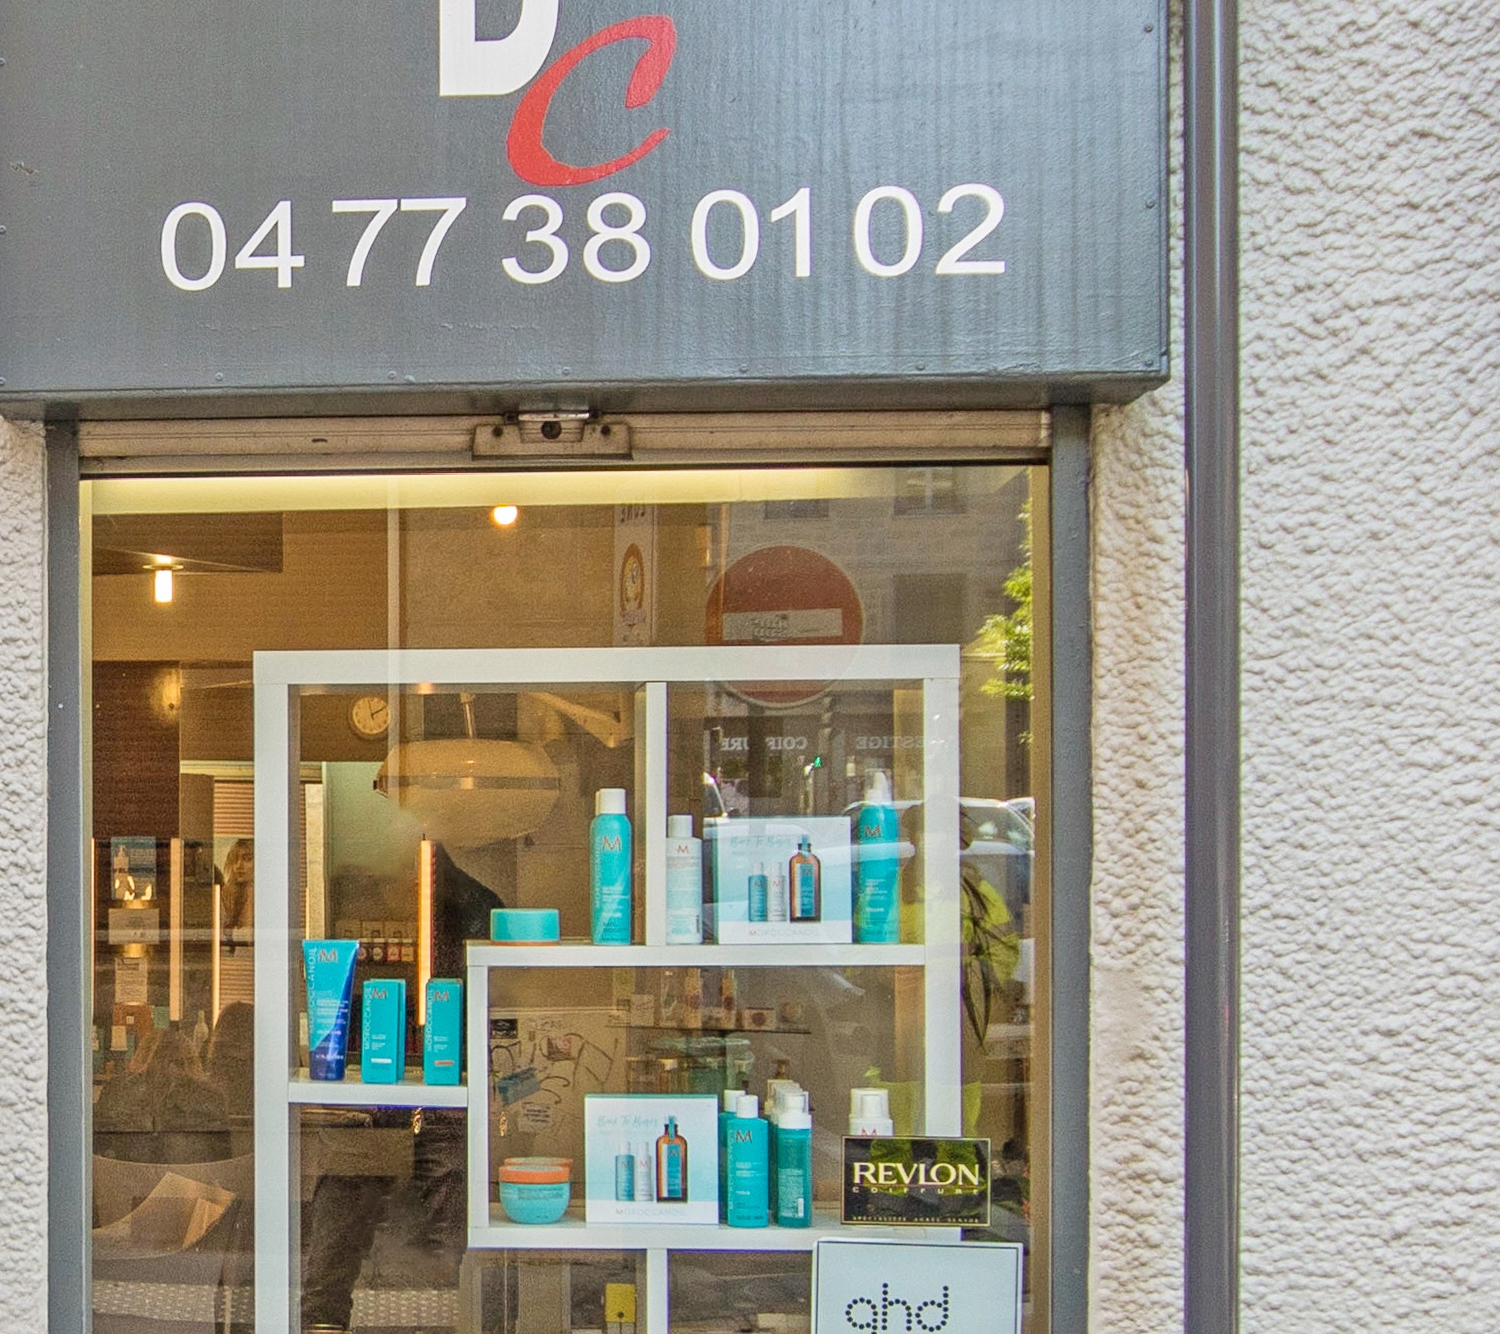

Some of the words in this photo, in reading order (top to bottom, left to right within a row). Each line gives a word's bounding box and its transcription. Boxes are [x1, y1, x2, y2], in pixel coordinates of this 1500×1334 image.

[161, 199, 305, 290] 04
[332, 196, 466, 287] 77
[501, 191, 650, 284] 38
[692, 187, 812, 278] 01
[853, 183, 1006, 276] 02
[853, 1161, 980, 1186] REVLON
